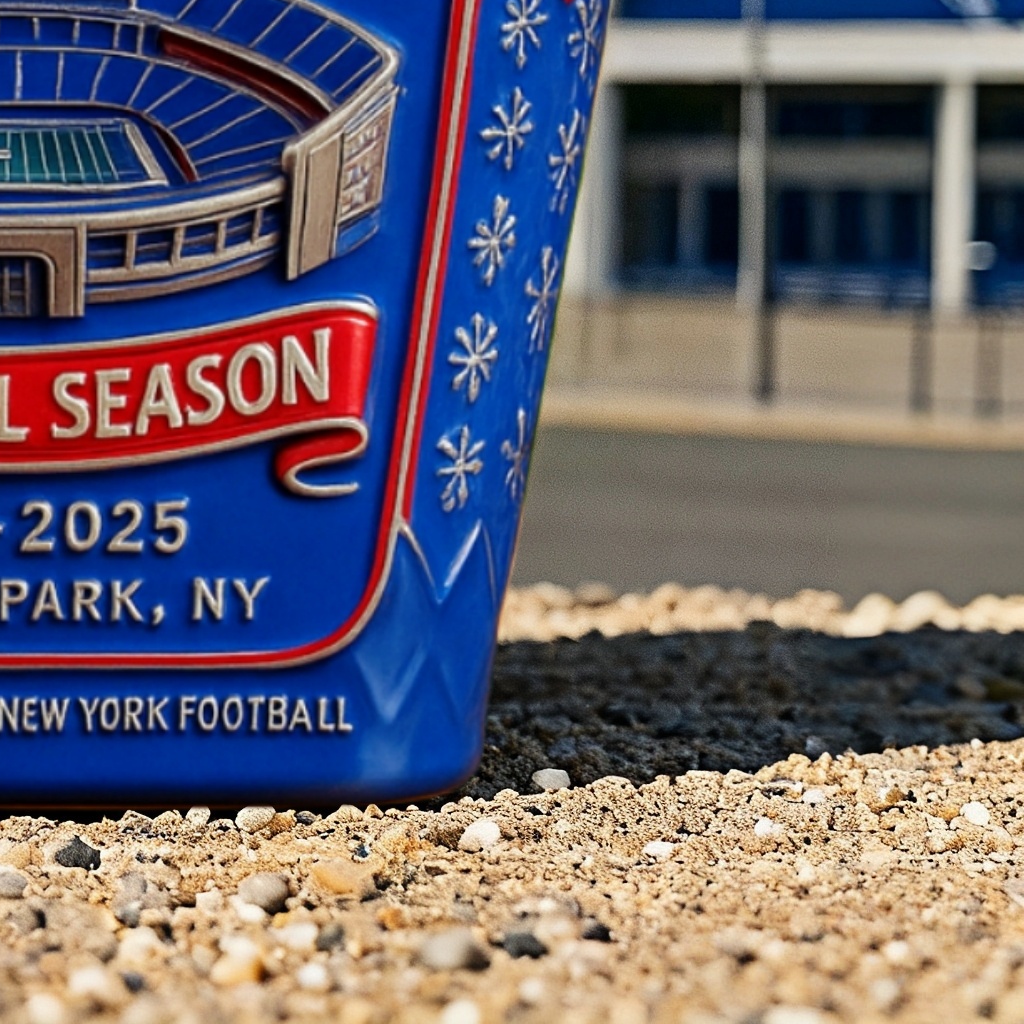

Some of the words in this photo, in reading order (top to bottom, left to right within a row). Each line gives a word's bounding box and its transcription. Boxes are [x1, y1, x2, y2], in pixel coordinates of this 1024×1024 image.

[51, 326, 332, 440] SEASON
[0, 578, 166, 626] PARK,
[191, 576, 271, 620] NY
[79, 695, 171, 732] YORK
[178, 693, 354, 733] FOOTBALL
